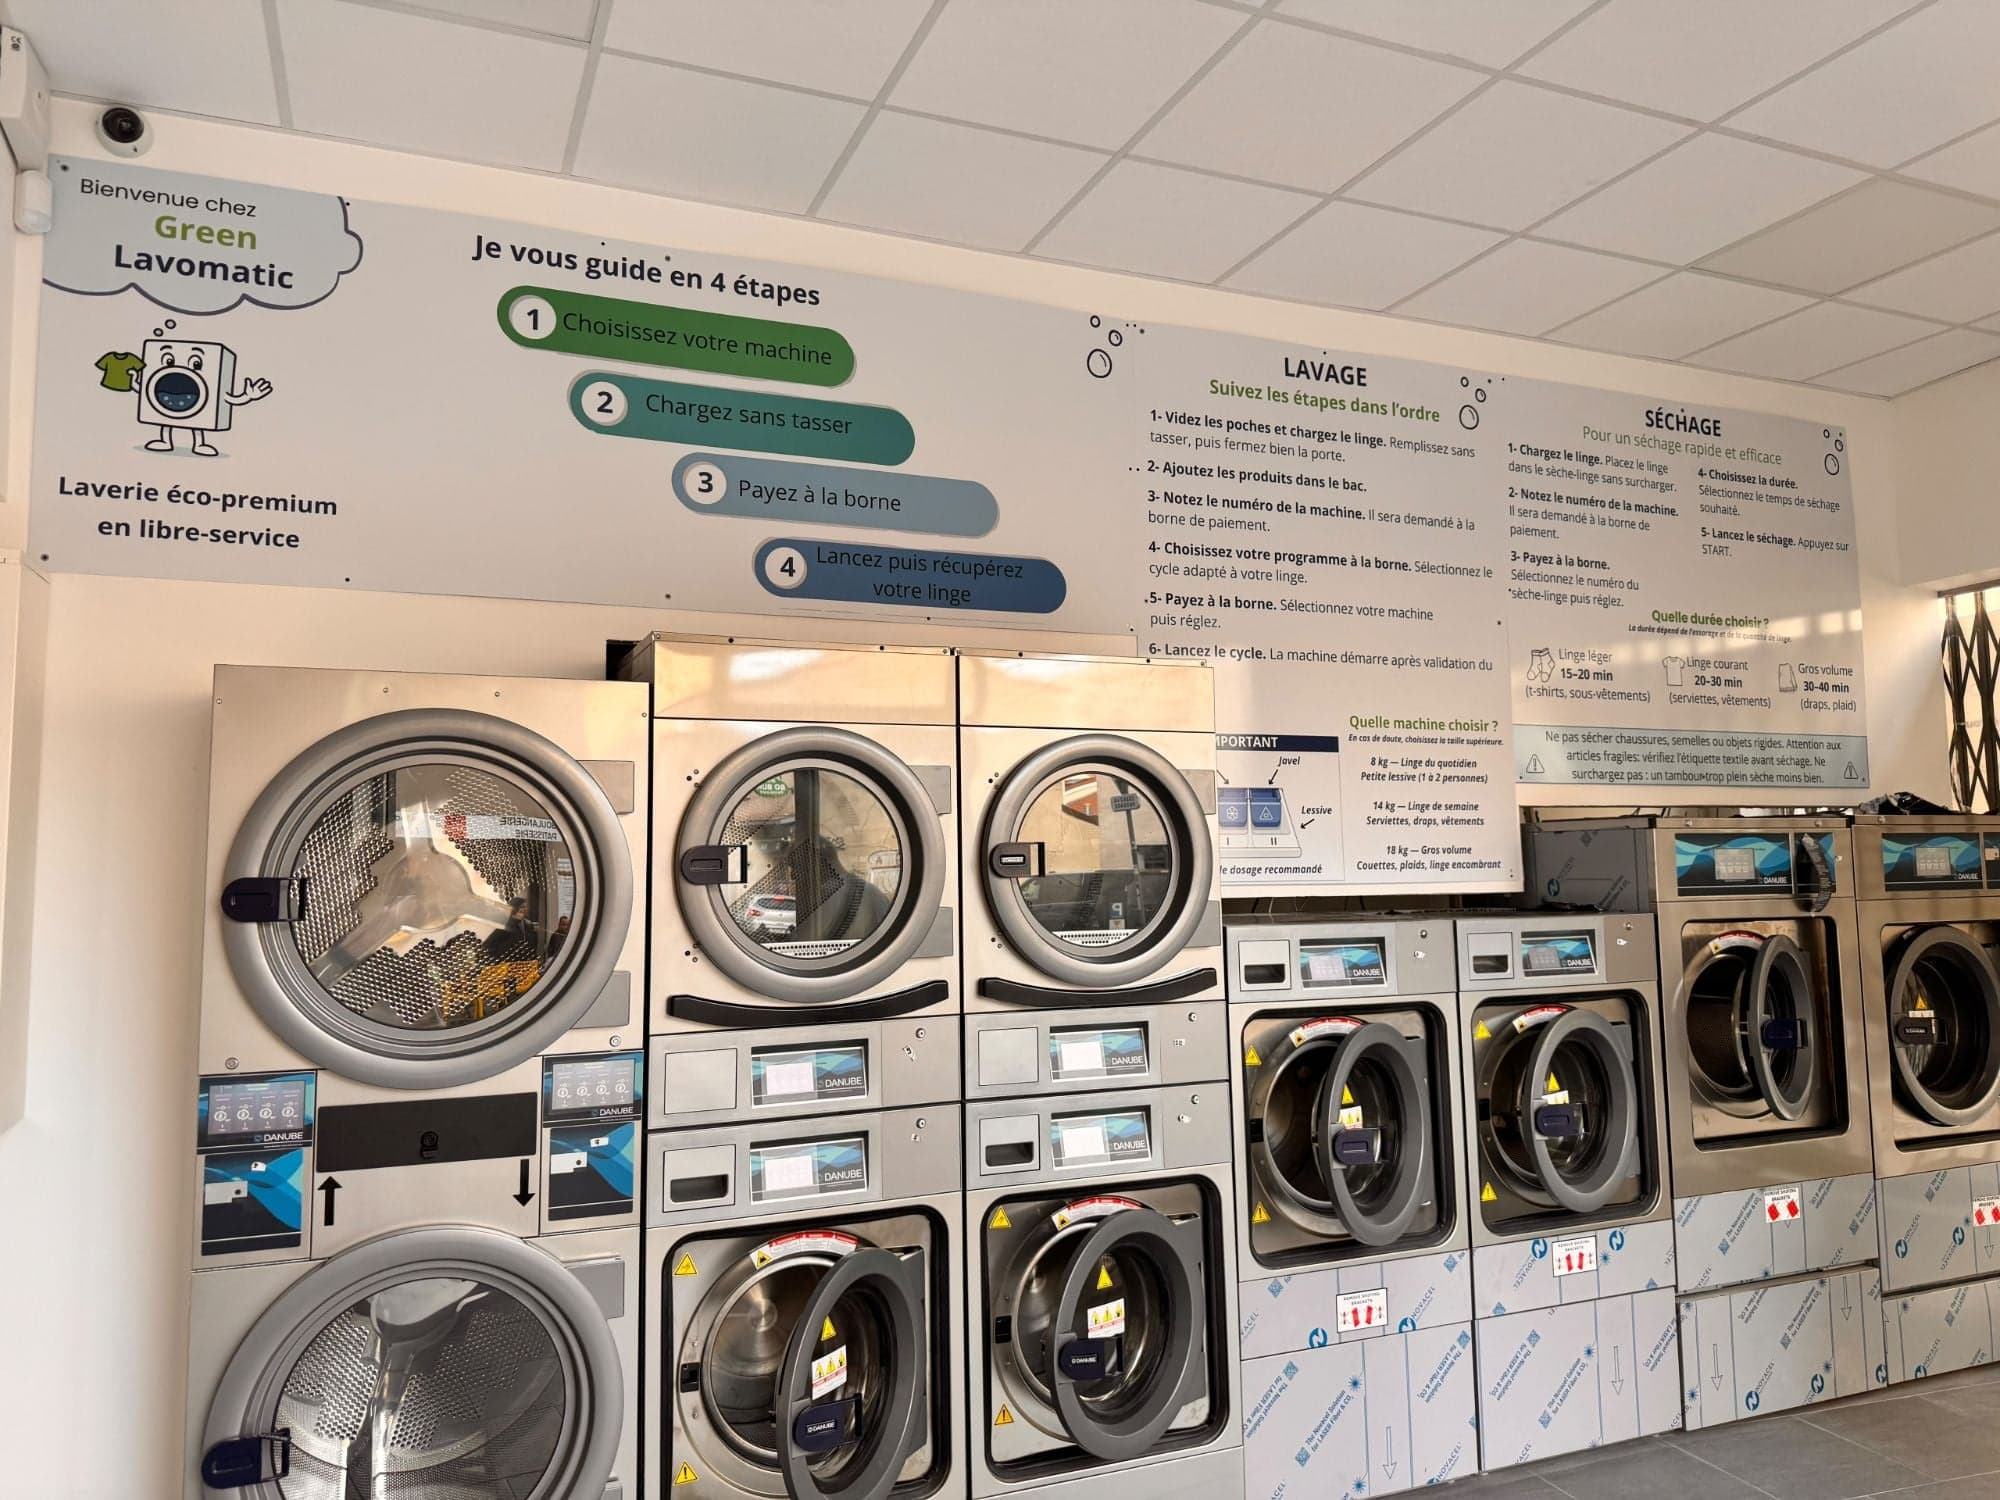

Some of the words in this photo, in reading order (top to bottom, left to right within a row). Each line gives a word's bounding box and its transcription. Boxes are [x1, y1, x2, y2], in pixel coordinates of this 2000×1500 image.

[80, 178, 199, 209] Bienvenue
[205, 197, 256, 218] chez
[154, 215, 256, 250] Green
[114, 244, 294, 289] Lavomatic
[471, 234, 502, 261] Je
[509, 244, 578, 270] vous
[584, 256, 662, 283] guide
[670, 268, 703, 290] en
[710, 272, 726, 292] 4
[733, 274, 820, 306] étapes
[526, 308, 538, 331] 1
[563, 312, 677, 345] Choisissez
[682, 332, 738, 353] votre
[745, 341, 832, 365] machine
[1284, 357, 1367, 387] LAVAGE
[596, 390, 613, 414] 2
[1209, 379, 1263, 400] Suivez
[1267, 385, 1289, 403] les
[1293, 389, 1346, 412] étapes
[1350, 396, 1388, 416] dans
[1391, 401, 1440, 422] l'ordre
[646, 393, 733, 423] Chargez
[739, 408, 786, 427] sans
[791, 412, 853, 434] tasser
[1645, 407, 1721, 437] SÉCHAGE
[1150, 409, 1162, 422] 1-
[1165, 410, 1201, 426] Videz
[1204, 414, 1223, 428] les
[1226, 419, 1271, 434] poches
[1274, 424, 1287, 436] et
[1289, 424, 1338, 443] chargez
[1340, 430, 1351, 443] le
[1354, 431, 1386, 449] linge.
[1389, 436, 1448, 455] Remplissez
[1450, 446, 1475, 458] sans
[1582, 425, 1612, 442] Pour
[1615, 433, 1633, 445] un
[1633, 433, 1682, 455] séchage
[1684, 442, 1722, 459] rapide
[1724, 447, 1737, 460] et
[1738, 447, 1782, 465] efficace
[1507, 442, 1517, 453] 1-
[1519, 443, 1562, 461] Chargez
[1563, 448, 1573, 461] le
[1575, 450, 1603, 467] linge.
[1605, 455, 1634, 469] Placez
[1636, 458, 1644, 471] le
[1646, 460, 1668, 476] linge
[697, 471, 713, 493] 3
[1147, 459, 1160, 472] 2-
[1162, 461, 1214, 478] Ajoutez
[1217, 465, 1235, 479] les
[1238, 469, 1293, 485] produits
[1295, 473, 1325, 488] dans
[1328, 476, 1339, 489] le
[1342, 477, 1367, 492] bac.
[59, 476, 159, 502] Laverie
[166, 484, 337, 516] éco-premium
[739, 479, 798, 504] Payez
[803, 484, 814, 503] à
[822, 486, 838, 506] la
[844, 488, 901, 512] borne
[97, 520, 130, 537] en
[140, 518, 299, 548] libre-service
[1700, 526, 1710, 537] 5-
[1711, 527, 1744, 541] Lancez
[1745, 530, 1755, 542] le
[1756, 532, 1796, 548] séchage.
[1797, 536, 1834, 552] Appuyez
[1835, 542, 1849, 551] sur
[779, 556, 796, 577] 4
[816, 545, 883, 568] Lancez
[888, 552, 928, 574] puis
[933, 555, 1023, 580] récupérez
[1148, 540, 1160, 553] 4-
[1164, 541, 1232, 558] Choisissez
[1235, 548, 1271, 561] votre
[1274, 551, 1347, 566] programme
[1350, 554, 1358, 567] à
[1360, 555, 1371, 568] la
[1374, 556, 1412, 572] borne.
[1414, 560, 1480, 577] Sélectionnez
[1483, 566, 1492, 578] le
[1148, 561, 1180, 578] cycle
[1182, 563, 1226, 581] adapté
[1229, 565, 1238, 579] à
[1240, 569, 1272, 581] votre
[1276, 568, 1308, 586] linge.
[870, 582, 924, 606] votre
[928, 583, 974, 609] linge
[1558, 647, 1586, 664] Linge
[1587, 648, 1612, 666] léger
[1560, 667, 1590, 680] 15-20
[1592, 669, 1613, 681] min
[1694, 674, 1722, 687] 20-30
[1724, 676, 1742, 688] min
[1568, 687, 1651, 703] sous-vêtements)
[1720, 693, 1771, 709] vêtements)
[1349, 715, 1390, 730] Quelle
[1393, 716, 1446, 731] machine
[1448, 718, 1490, 732] choisir
[1491, 720, 1498, 732] ?
[1276, 755, 1300, 767] Javel
[1370, 756, 1376, 766] 8
[1377, 756, 1388, 769] kg
[1400, 757, 1423, 770] Linge
[1424, 757, 1436, 767] du
[1436, 758, 1477, 770] quotidien
[1360, 770, 1386, 781] Petite
[1388, 771, 1416, 782] lessive
[1418, 772, 1426, 783] (1
[1428, 772, 1434, 782] à
[1434, 772, 1441, 782] 2
[1442, 774, 1488, 784] personnes)
[1300, 805, 1332, 815] Lessive
[1440, 815, 1484, 826] vêtements
[1229, 864, 1262, 877] dosage
[1264, 863, 1322, 874] recommandé
[1429, 859, 1450, 872] linge
[1451, 859, 1501, 869] encombrant
[1764, 876, 1787, 885] DANUBE
[1566, 957, 1593, 967] DANUBE
[1112, 1056, 1144, 1065] DANUBE
[825, 1077, 862, 1088] DANUBE
[600, 1106, 634, 1117] DANUBE
[264, 1131, 303, 1143] DANUBE
[1113, 1141, 1146, 1150] DANUBE
[824, 1170, 862, 1182] DANUBE
